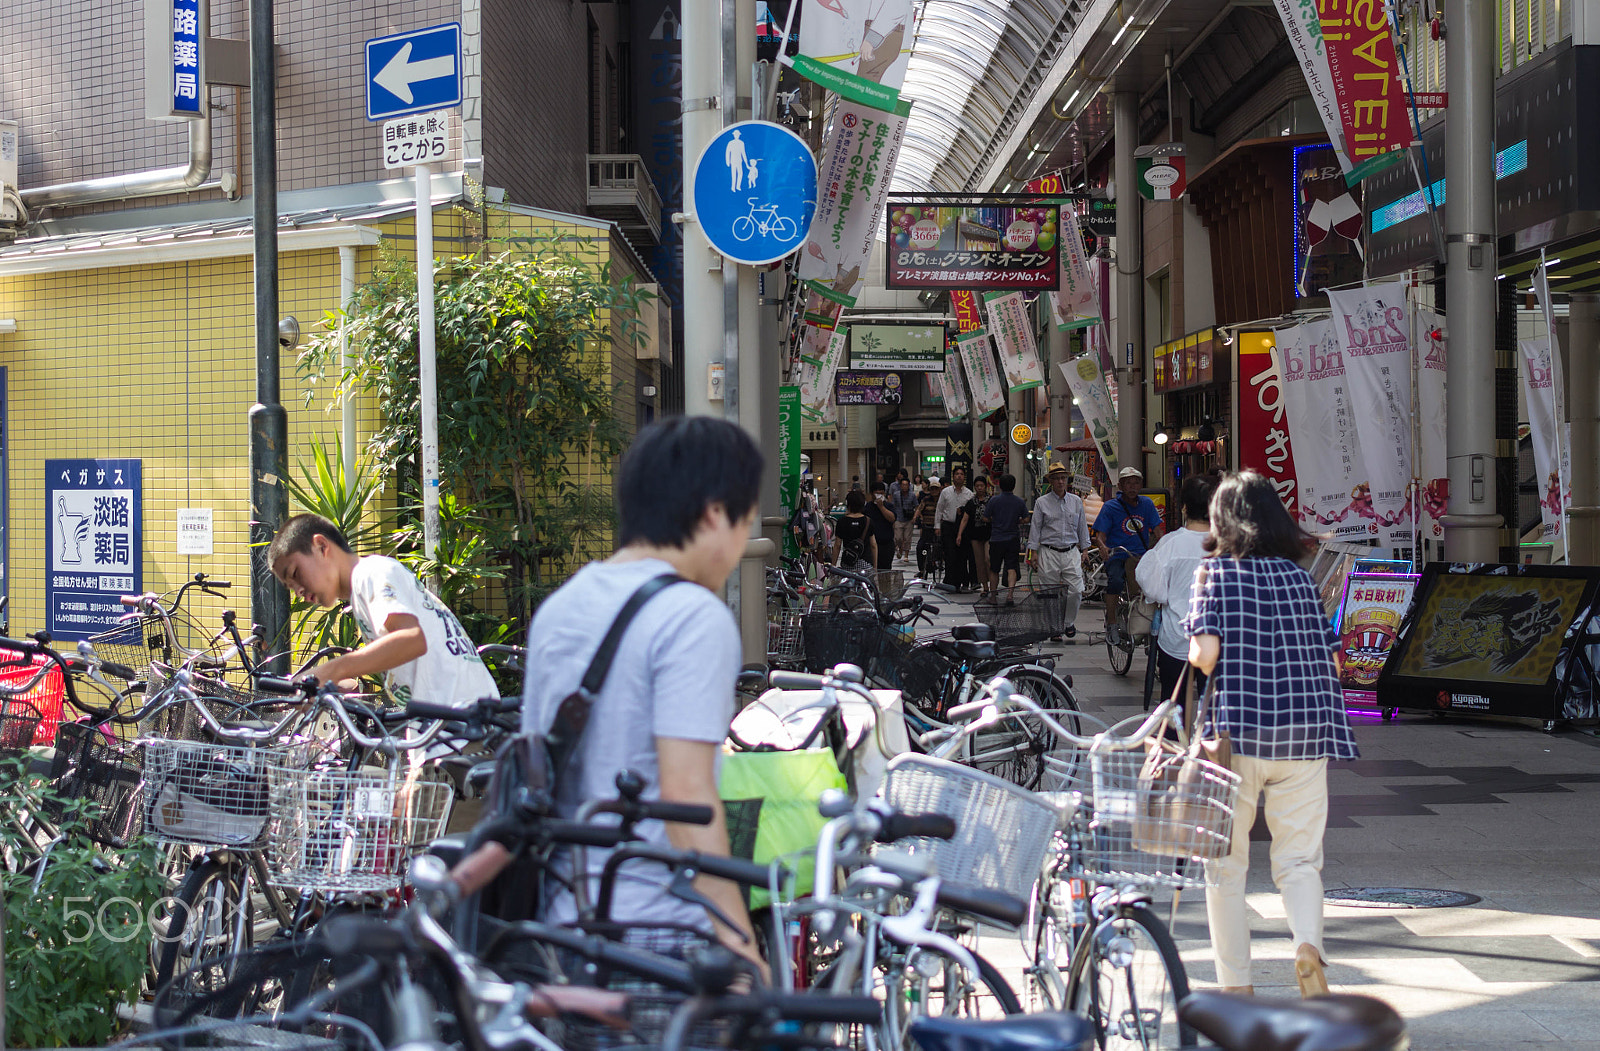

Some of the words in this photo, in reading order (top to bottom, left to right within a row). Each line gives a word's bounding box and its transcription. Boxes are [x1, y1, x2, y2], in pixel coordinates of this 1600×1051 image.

[174, 0, 197, 99] 路薬局
[821, 70, 845, 86] Improving
[844, 80, 866, 93] Smoking
[865, 87, 890, 100] Manners
[386, 117, 445, 141] 自転車を除く
[387, 136, 445, 164] ここから
[859, 122, 890, 202] 住みよい街へ。
[831, 118, 873, 250] マナーの木を育てよう。
[913, 231, 940, 242] 366台
[1009, 228, 1034, 236] パチンコ
[1010, 235, 1032, 243] 専門店
[897, 252, 1051, 267] 8/6(土)グランドオープン
[849, 395, 864, 403] 243
[61, 468, 124, 485] ペガサス
[93, 495, 129, 528] 淡路
[94, 531, 129, 565] 薬局
[52, 576, 98, 589] 全国処方せん受付
[101, 578, 132, 589] 保険薬局
[1353, 588, 1406, 603] 本日取材!!
